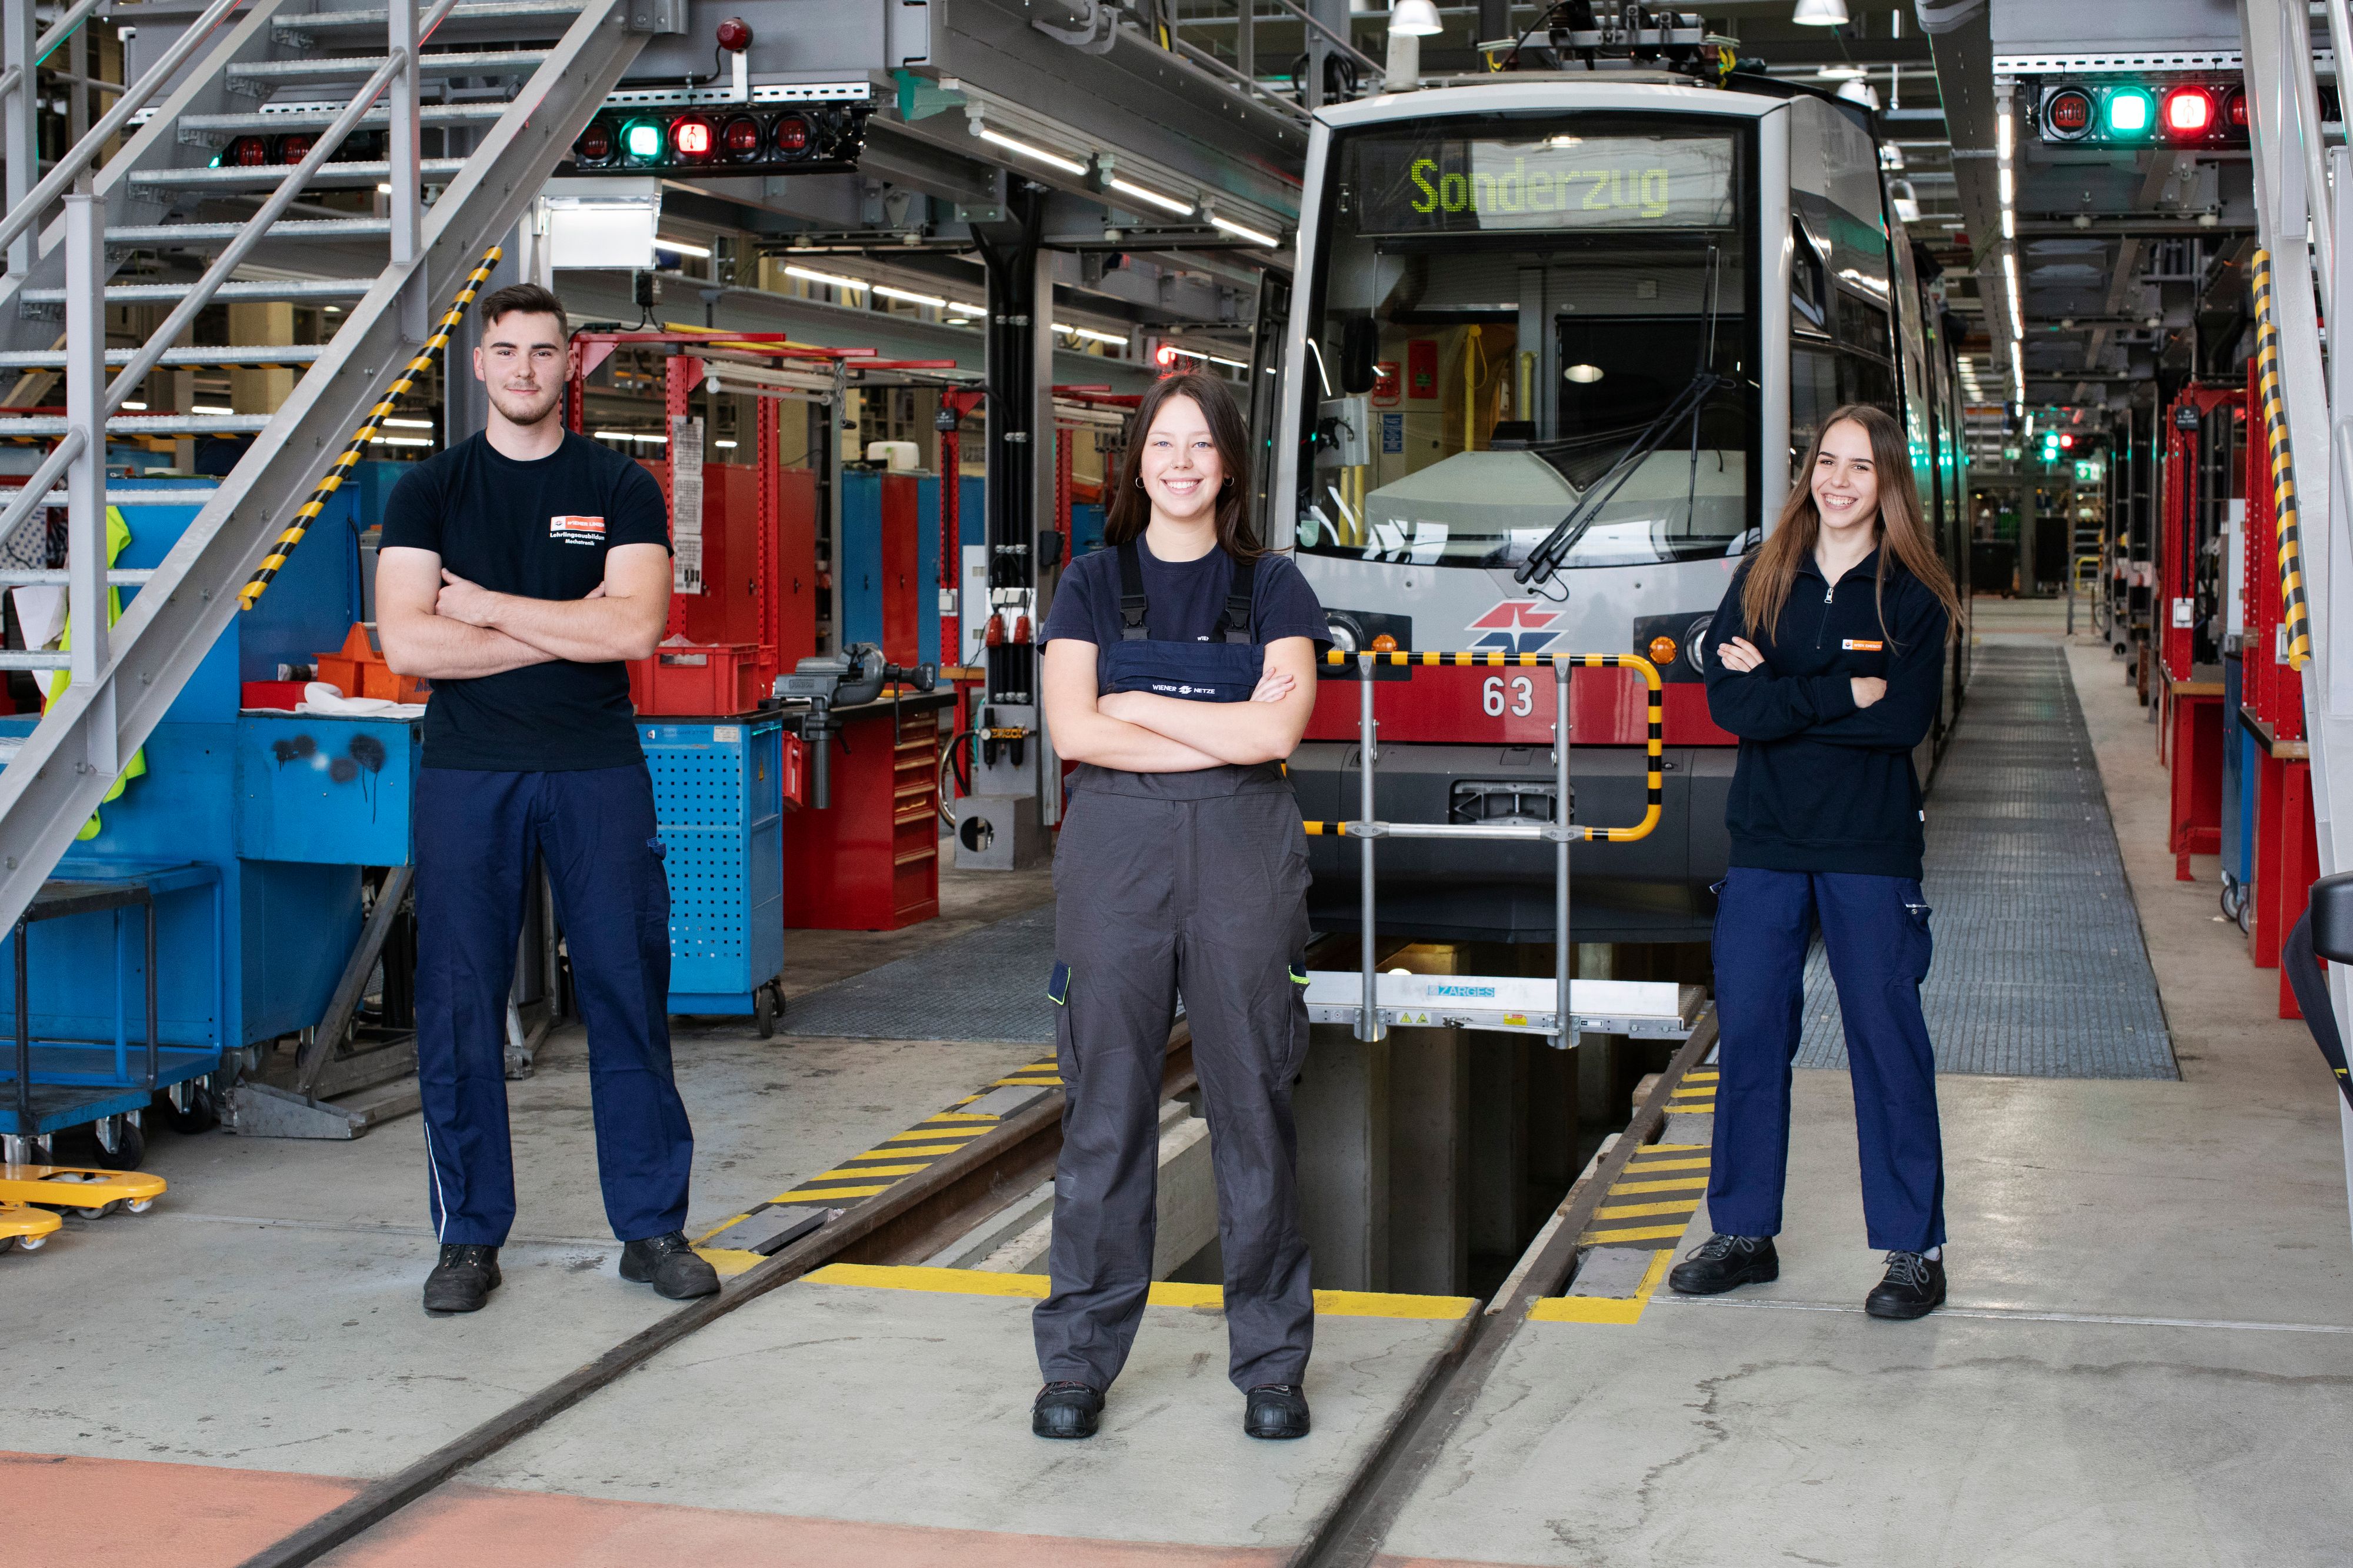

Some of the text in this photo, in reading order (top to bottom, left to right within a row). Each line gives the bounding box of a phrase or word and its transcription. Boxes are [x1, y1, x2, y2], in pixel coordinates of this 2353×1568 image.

[2058, 102, 2084, 121] 600
[1411, 157, 1668, 218] Sonderzug
[1483, 676, 1534, 717] 63
[1438, 986, 1494, 997] ZARGES
